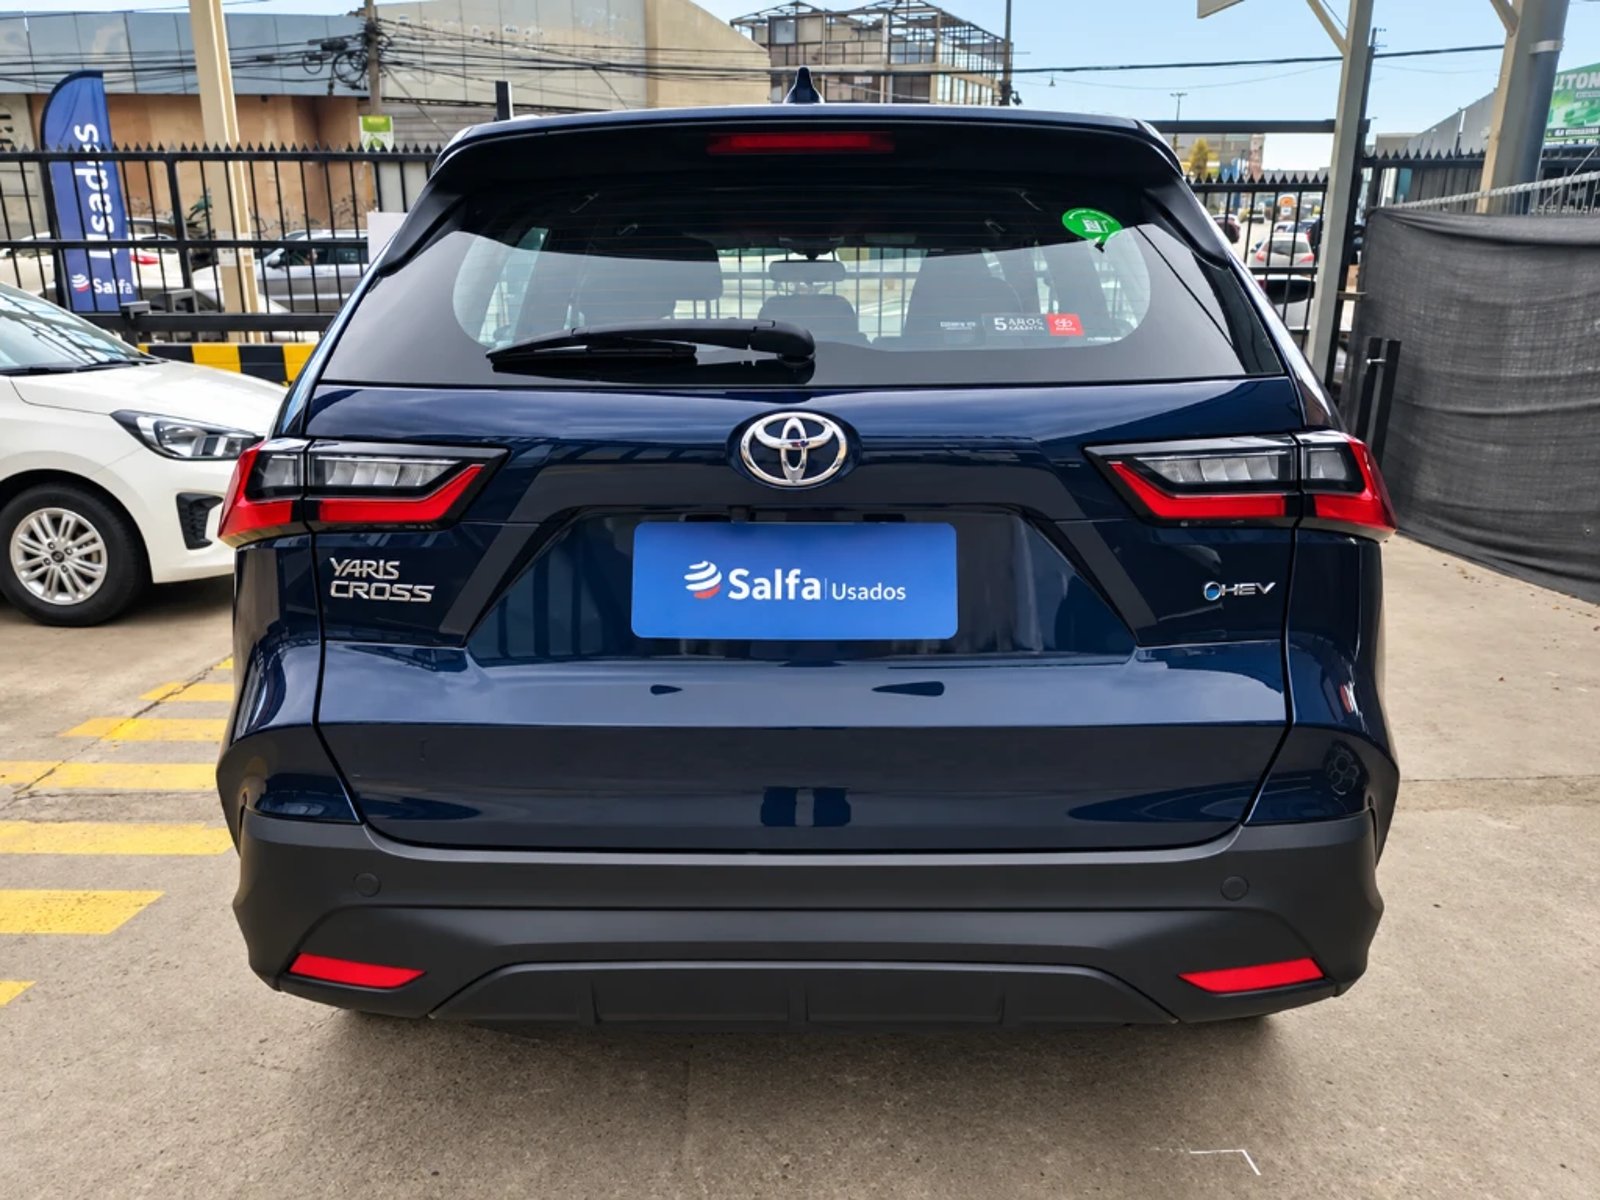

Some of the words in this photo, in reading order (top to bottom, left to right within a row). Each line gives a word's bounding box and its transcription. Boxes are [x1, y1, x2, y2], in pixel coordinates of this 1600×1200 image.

[93, 278, 133, 294] Salfa
[994, 317, 1007, 331] 5
[329, 557, 400, 580] YARIS
[330, 580, 435, 602] CROSS
[727, 567, 822, 601] Salfa
[832, 582, 907, 601] Usados
